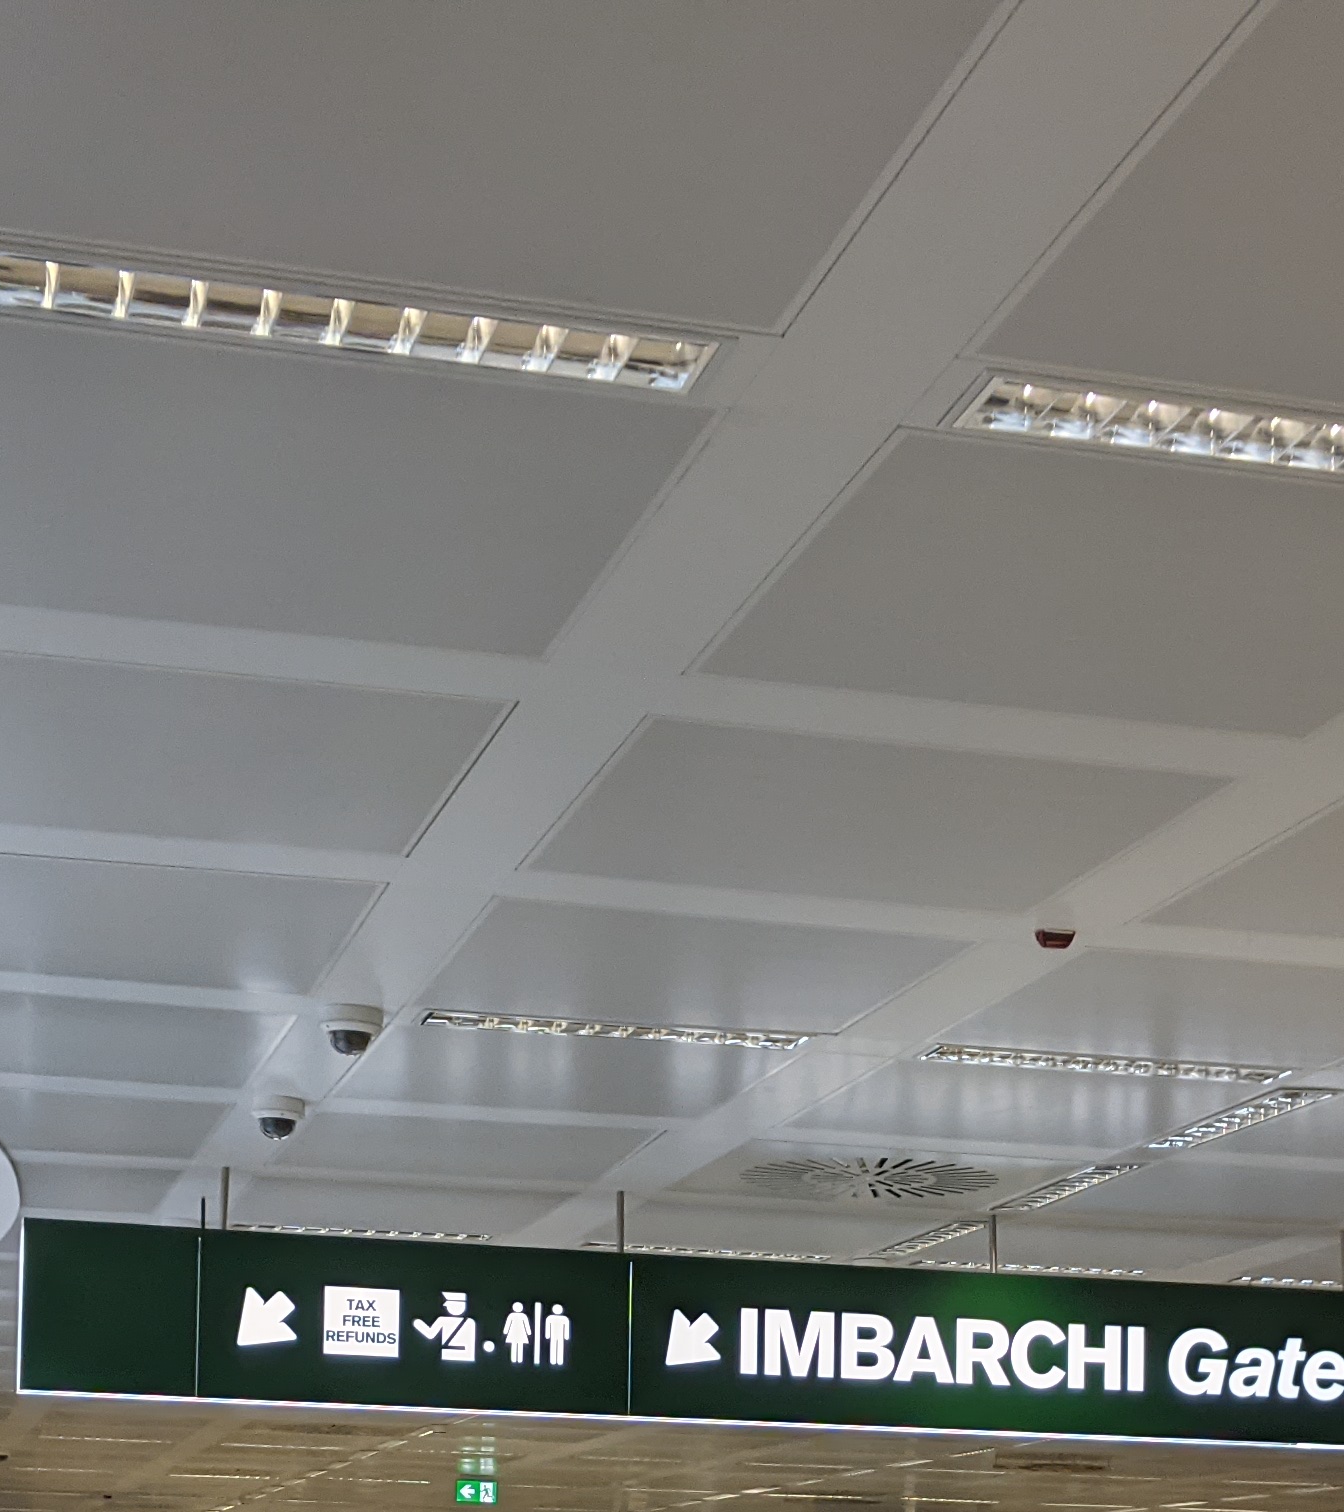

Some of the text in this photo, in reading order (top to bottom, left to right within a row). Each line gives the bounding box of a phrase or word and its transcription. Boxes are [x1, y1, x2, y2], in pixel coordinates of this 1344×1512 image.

[346, 1298, 376, 1311] TAX
[342, 1314, 381, 1328] FREE
[325, 1329, 397, 1345] REFUNDS
[739, 1307, 1146, 1393] IMBARCHI
